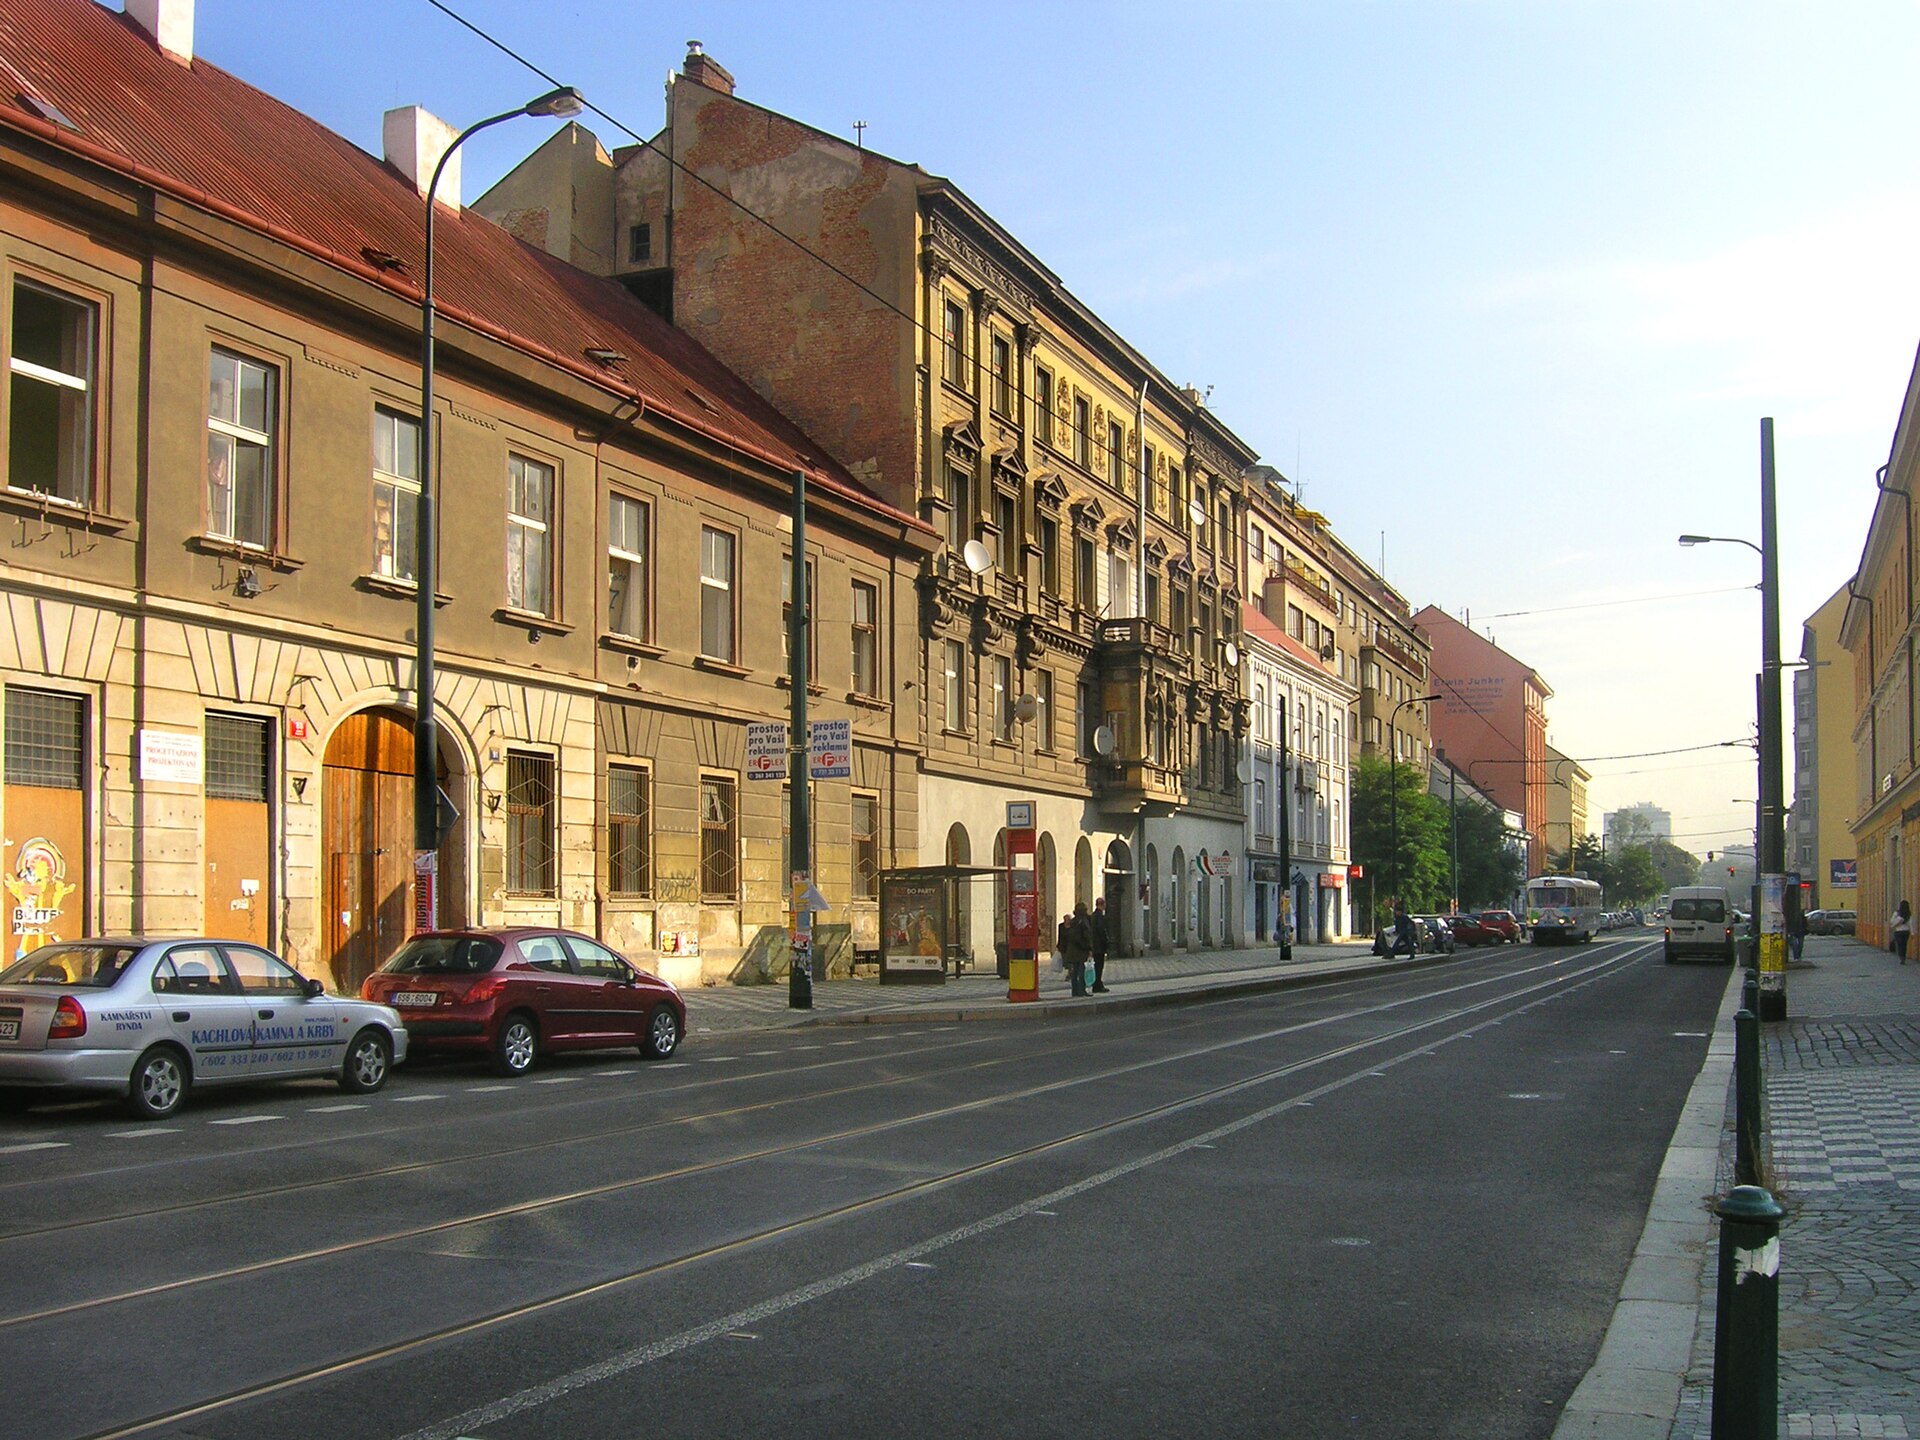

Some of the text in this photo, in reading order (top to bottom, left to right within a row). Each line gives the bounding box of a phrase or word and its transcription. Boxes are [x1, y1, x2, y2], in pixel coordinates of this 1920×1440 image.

[748, 724, 784, 736] prostor
[813, 721, 848, 733] prostor
[748, 734, 784, 747] pro Vaši
[813, 730, 848, 743] pro Vaši
[748, 746, 784, 756] reklamu
[813, 742, 848, 752] reklamu
[116, 1022, 143, 1031] RYNDA
[191, 1025, 336, 1044] KACHLOVÁ KAMNA A KRBY
